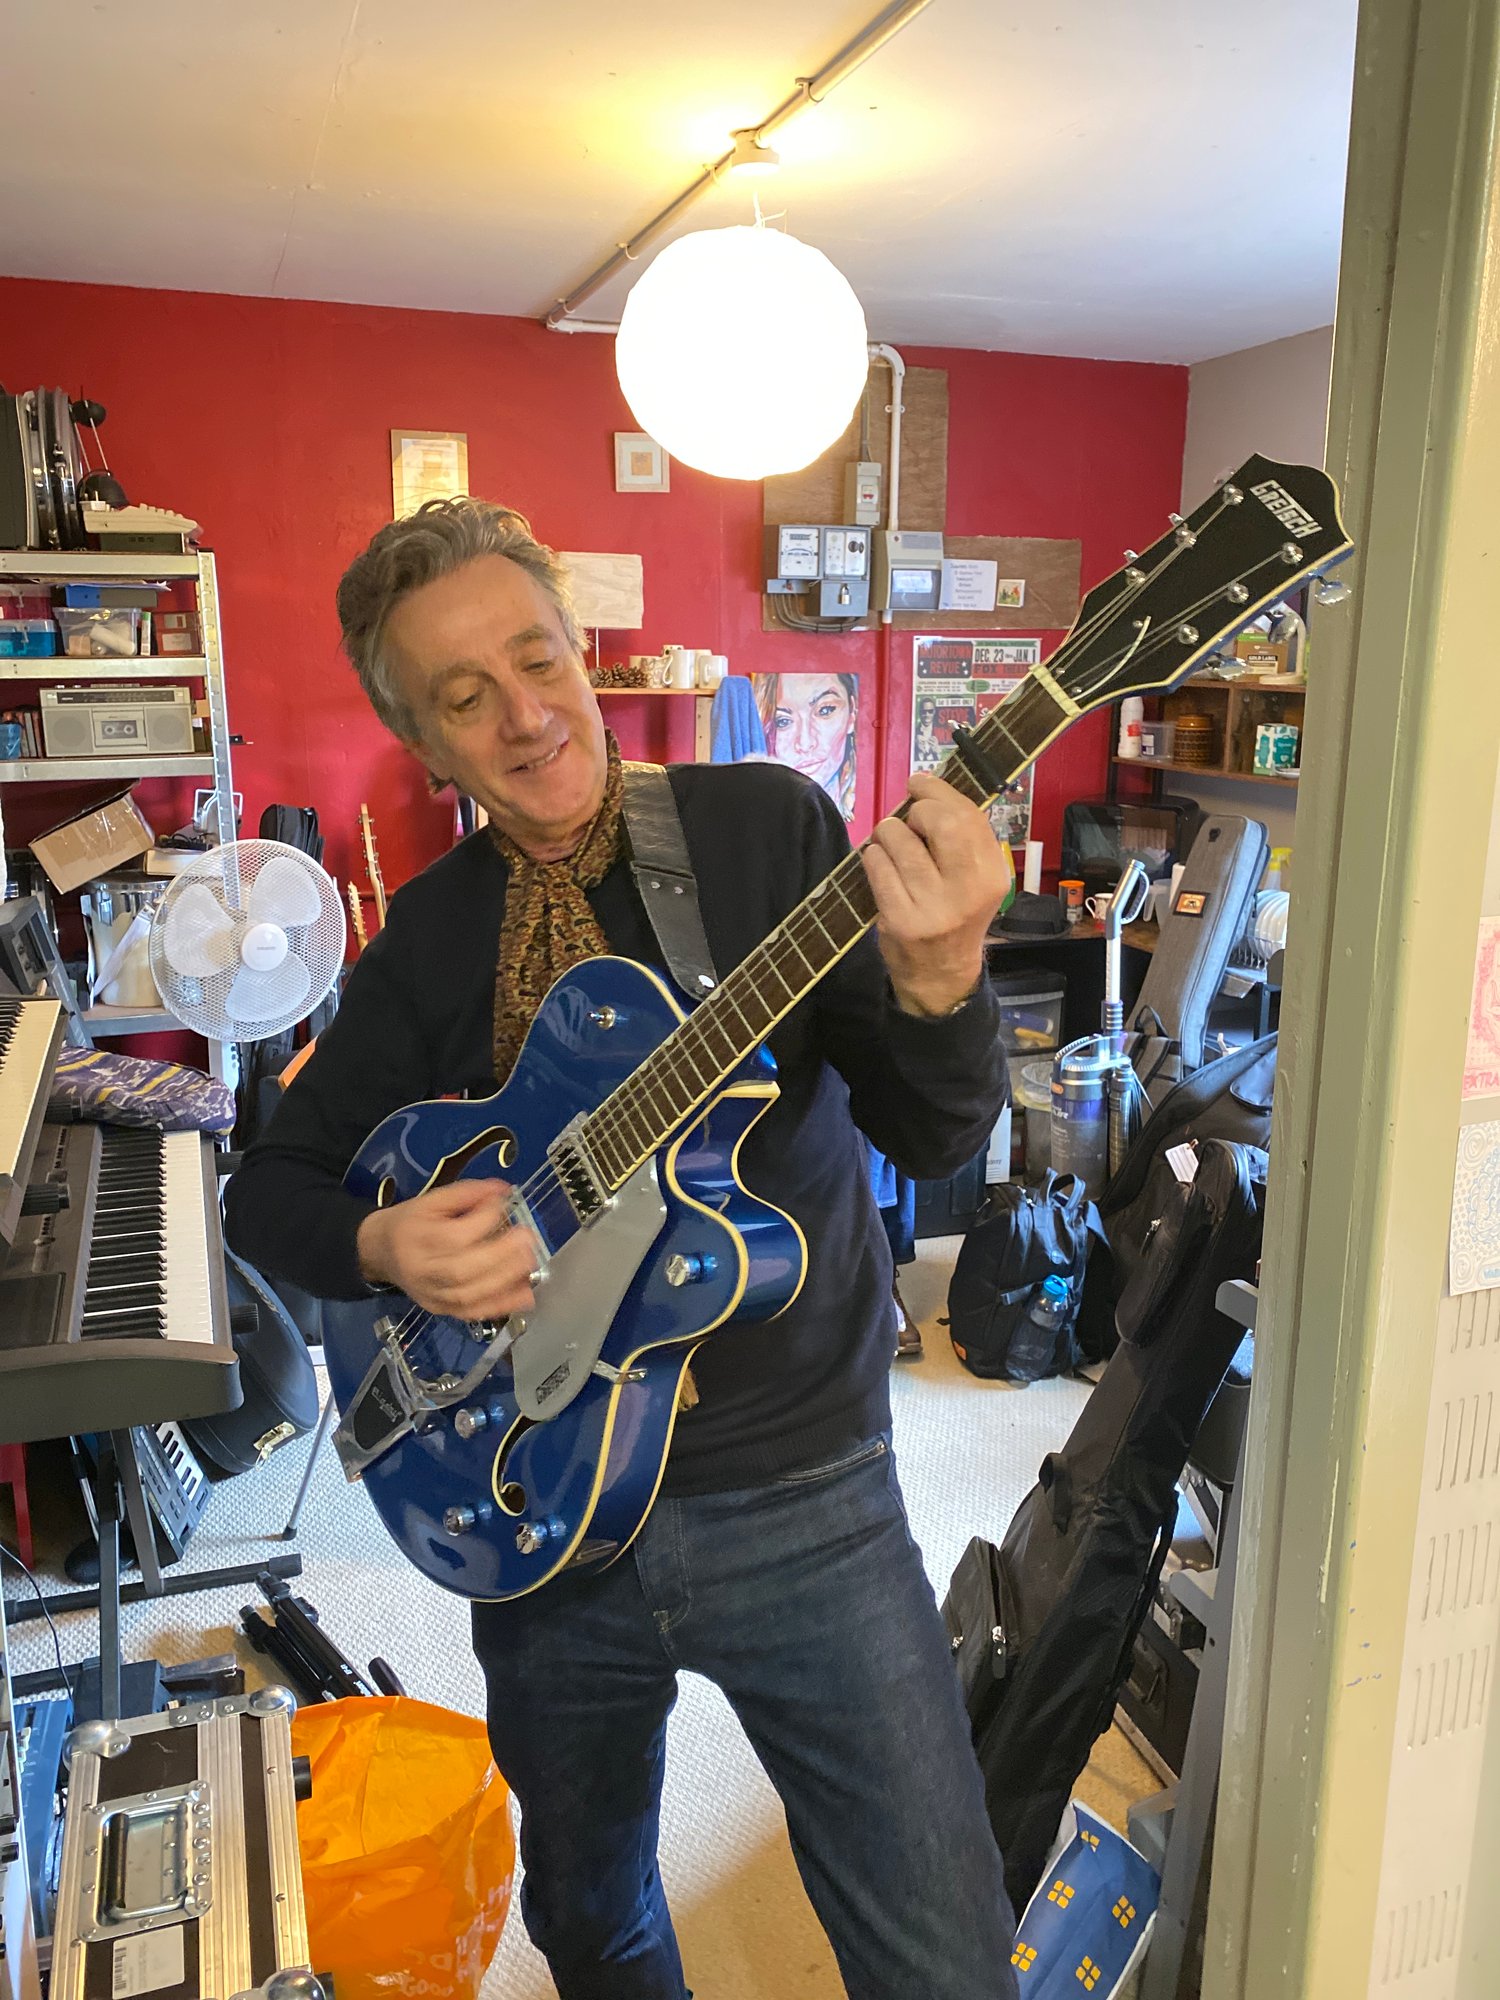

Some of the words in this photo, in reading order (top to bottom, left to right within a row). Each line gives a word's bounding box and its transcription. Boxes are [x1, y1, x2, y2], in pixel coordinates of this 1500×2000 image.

[1250, 480, 1323, 539] GRETSCH
[975, 648, 991, 663] DEC.
[993, 648, 1005, 663] 23
[1032, 648, 1036, 663] 1
[929, 661, 961, 674] REVUE
[974, 663, 997, 674] FOX
